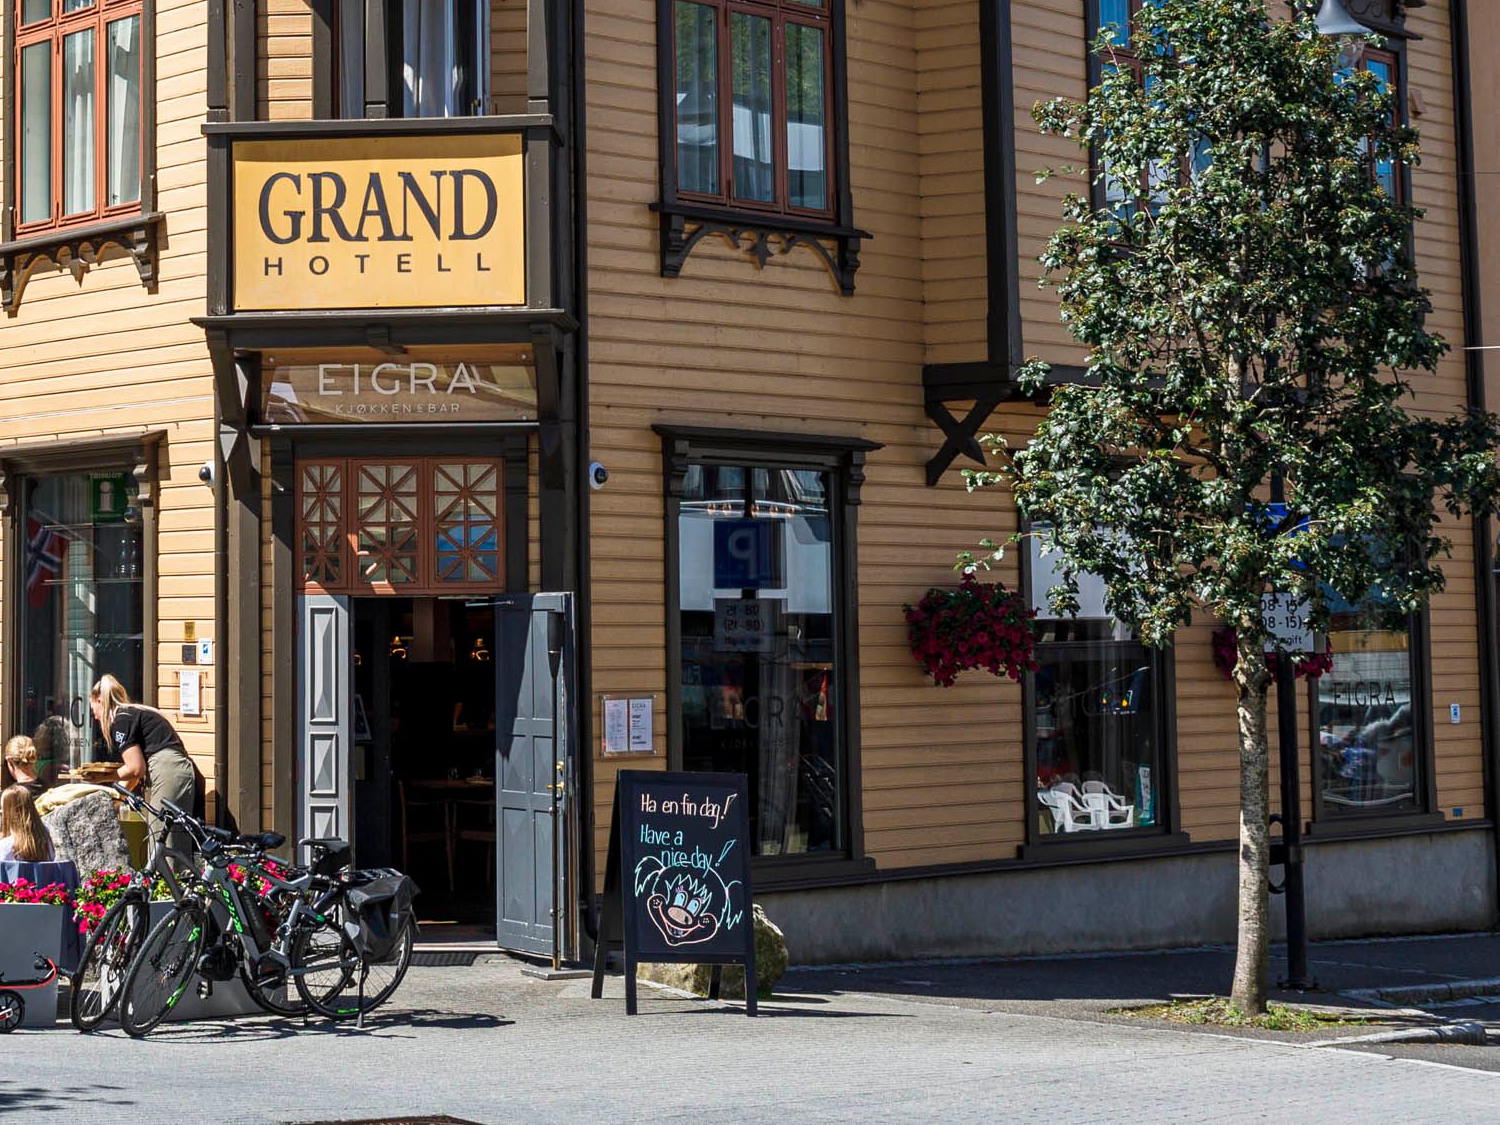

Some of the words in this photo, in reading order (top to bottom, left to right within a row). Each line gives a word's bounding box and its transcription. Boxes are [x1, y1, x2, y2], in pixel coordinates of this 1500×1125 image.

[258, 168, 498, 245] GRAND
[264, 252, 491, 276] HOTELL
[318, 362, 477, 396] EIGRA
[428, 403, 460, 413] BAR
[641, 793, 657, 813] Ha
[662, 799, 679, 813] en
[680, 793, 697, 817] fin
[640, 824, 670, 847] Have
[674, 830, 683, 846] a
